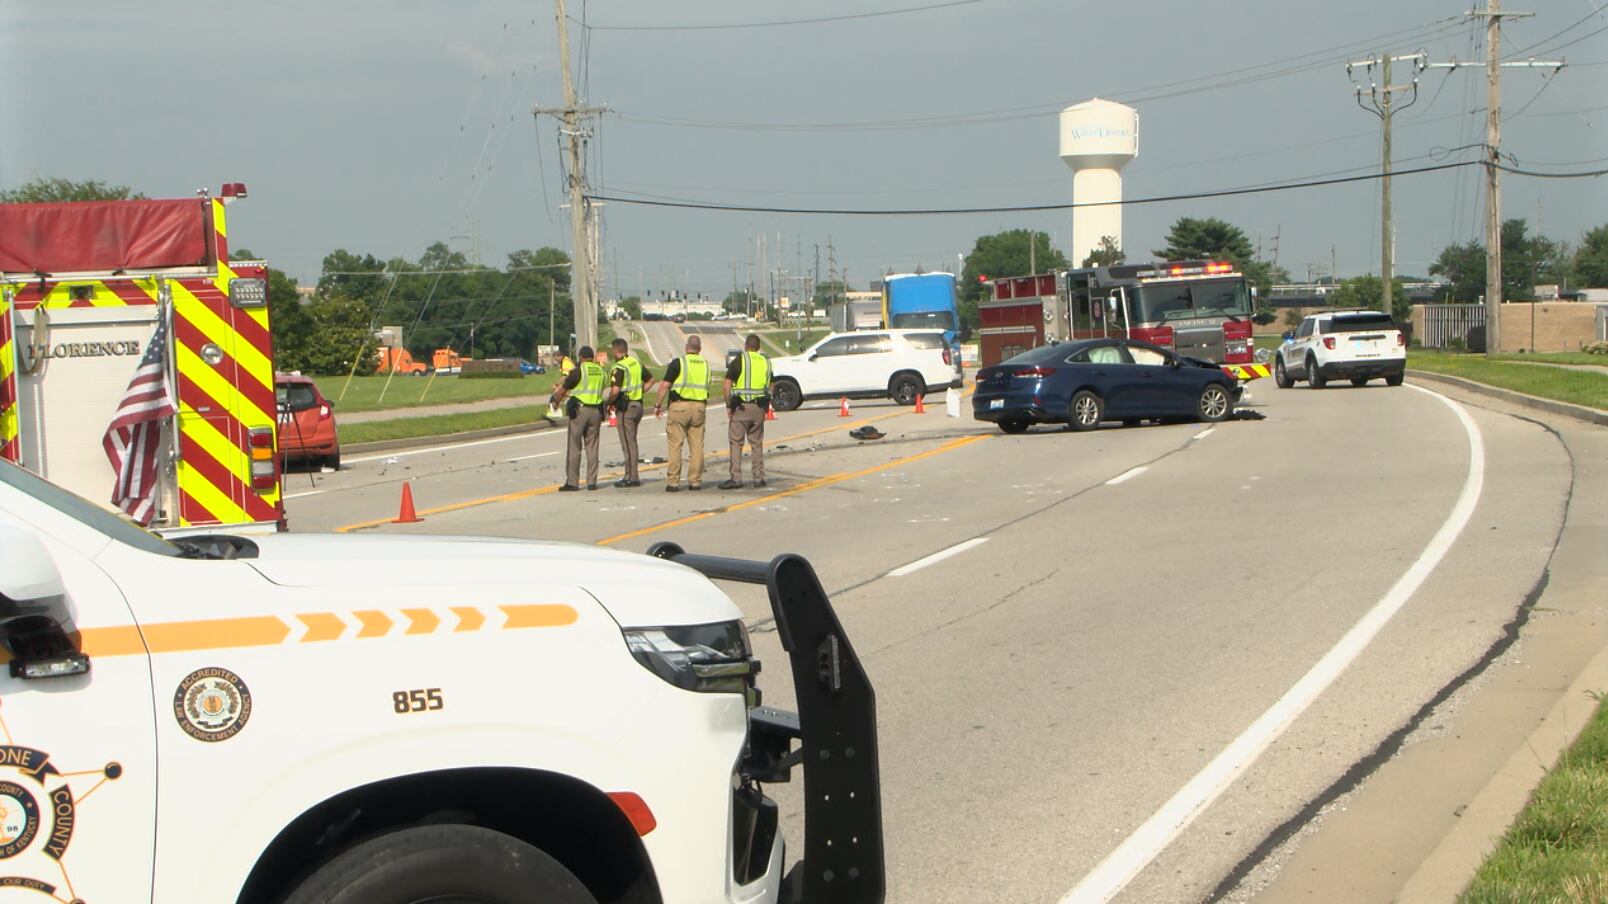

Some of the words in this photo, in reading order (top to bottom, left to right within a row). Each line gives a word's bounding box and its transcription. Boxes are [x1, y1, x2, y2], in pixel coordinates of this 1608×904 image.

[28, 341, 141, 359] FLORENCE
[182, 669, 238, 690] ACCREDITED
[393, 688, 443, 714] 855
[175, 701, 185, 718] LAW
[181, 720, 238, 741] ENFORCEMENT
[239, 693, 251, 725] AGENCY
[16, 816, 36, 849] KENTUCKY
[48, 790, 72, 856] COUNTY
